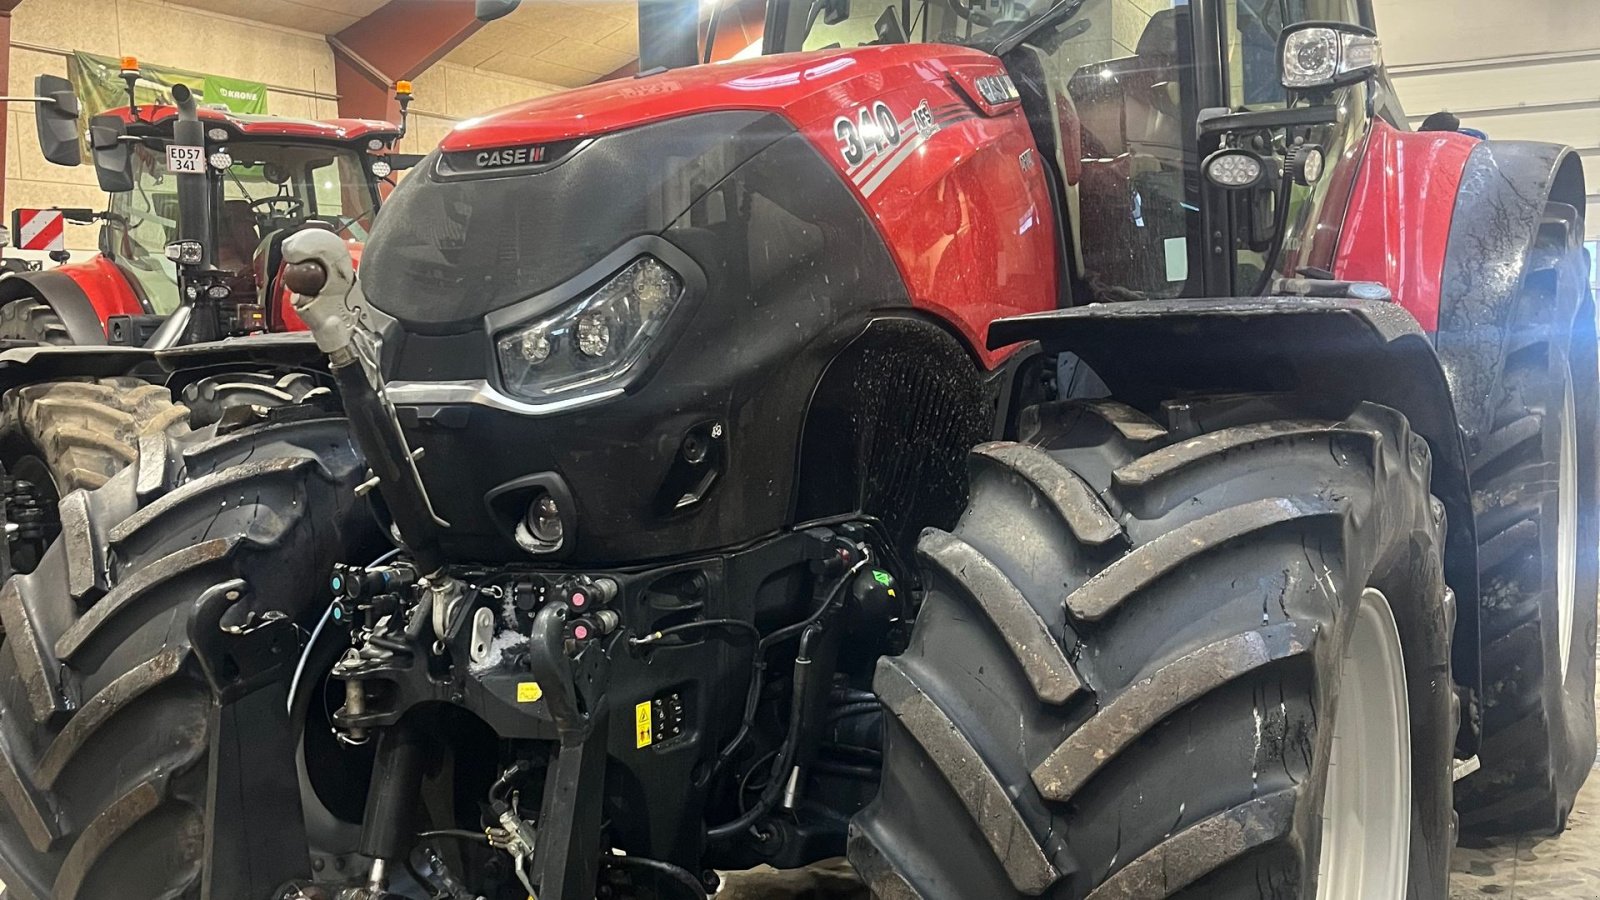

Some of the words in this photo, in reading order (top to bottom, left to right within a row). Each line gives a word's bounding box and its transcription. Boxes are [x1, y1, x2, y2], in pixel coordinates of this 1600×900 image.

[227, 90, 257, 101] KRONE
[833, 100, 902, 167] 340
[170, 148, 201, 160] ED57
[476, 149, 526, 167] CASE
[176, 160, 196, 171] 341
